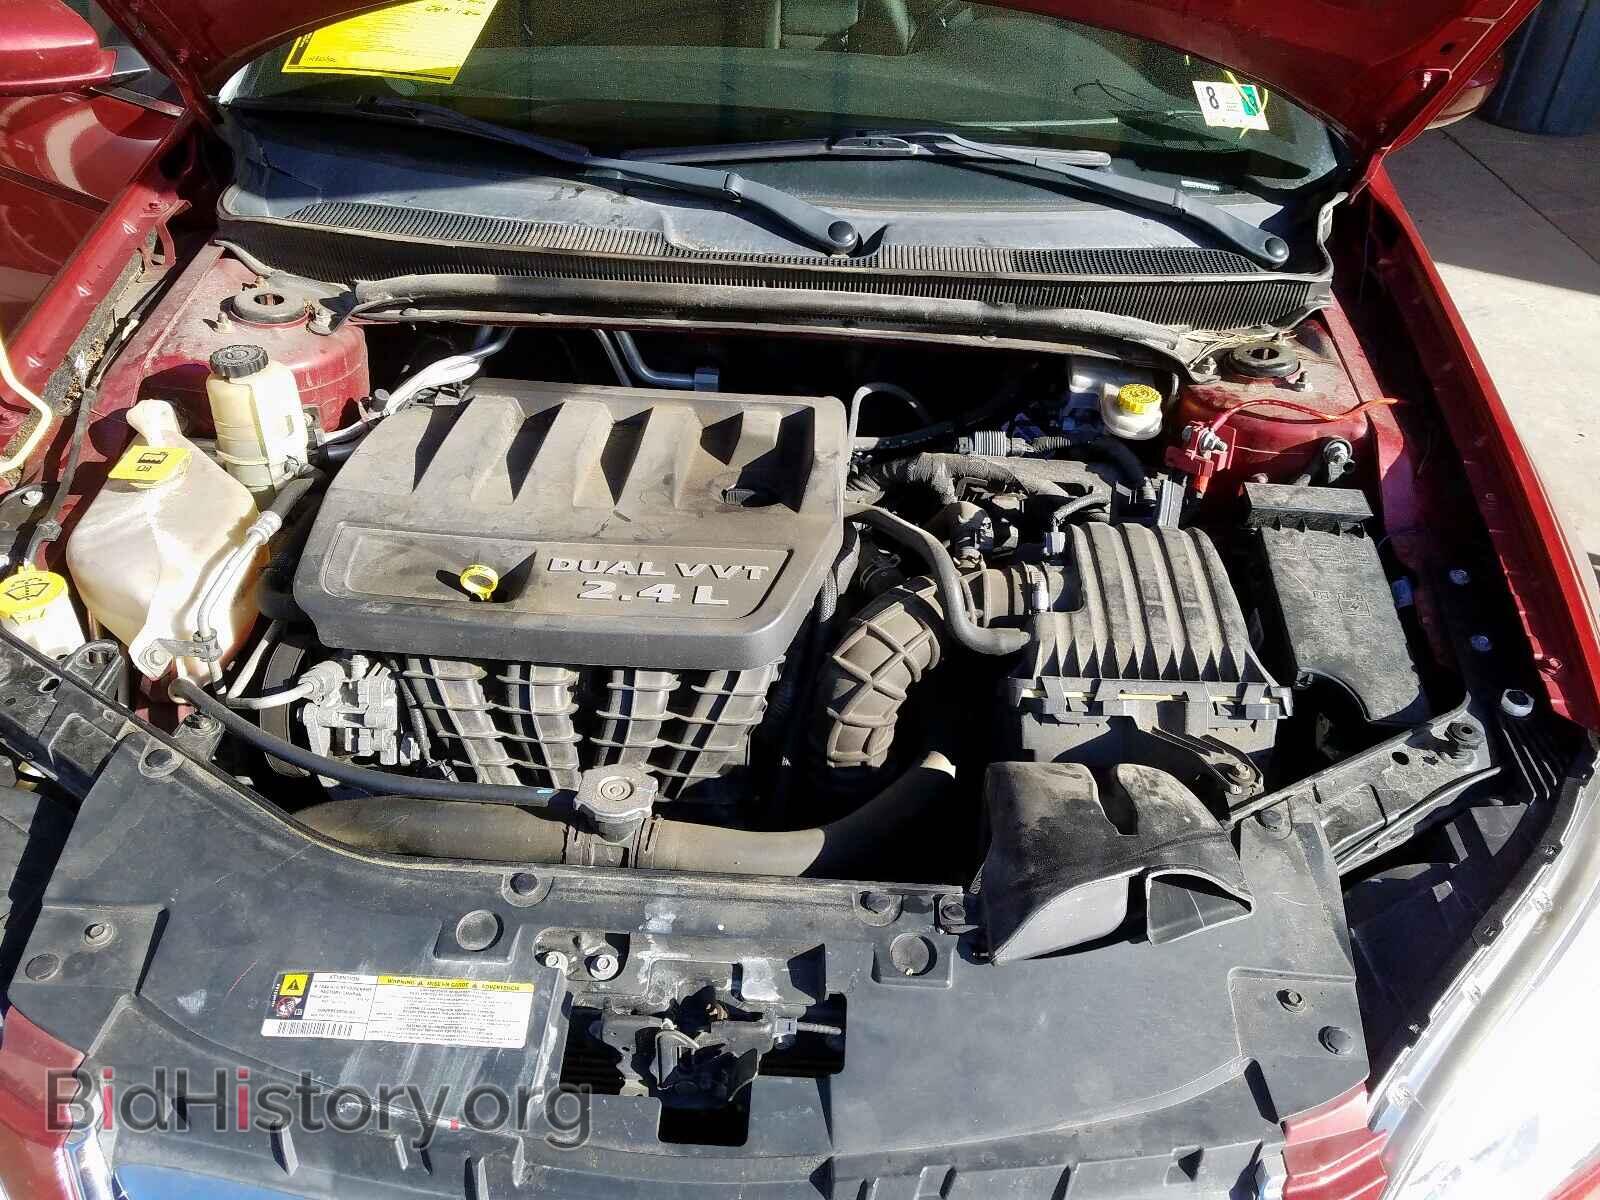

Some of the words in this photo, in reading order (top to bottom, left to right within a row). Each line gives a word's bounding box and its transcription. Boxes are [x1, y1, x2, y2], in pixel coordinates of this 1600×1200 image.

[1205, 86, 1219, 109] 8
[548, 558, 665, 576] DUAL
[674, 563, 769, 580] VVT
